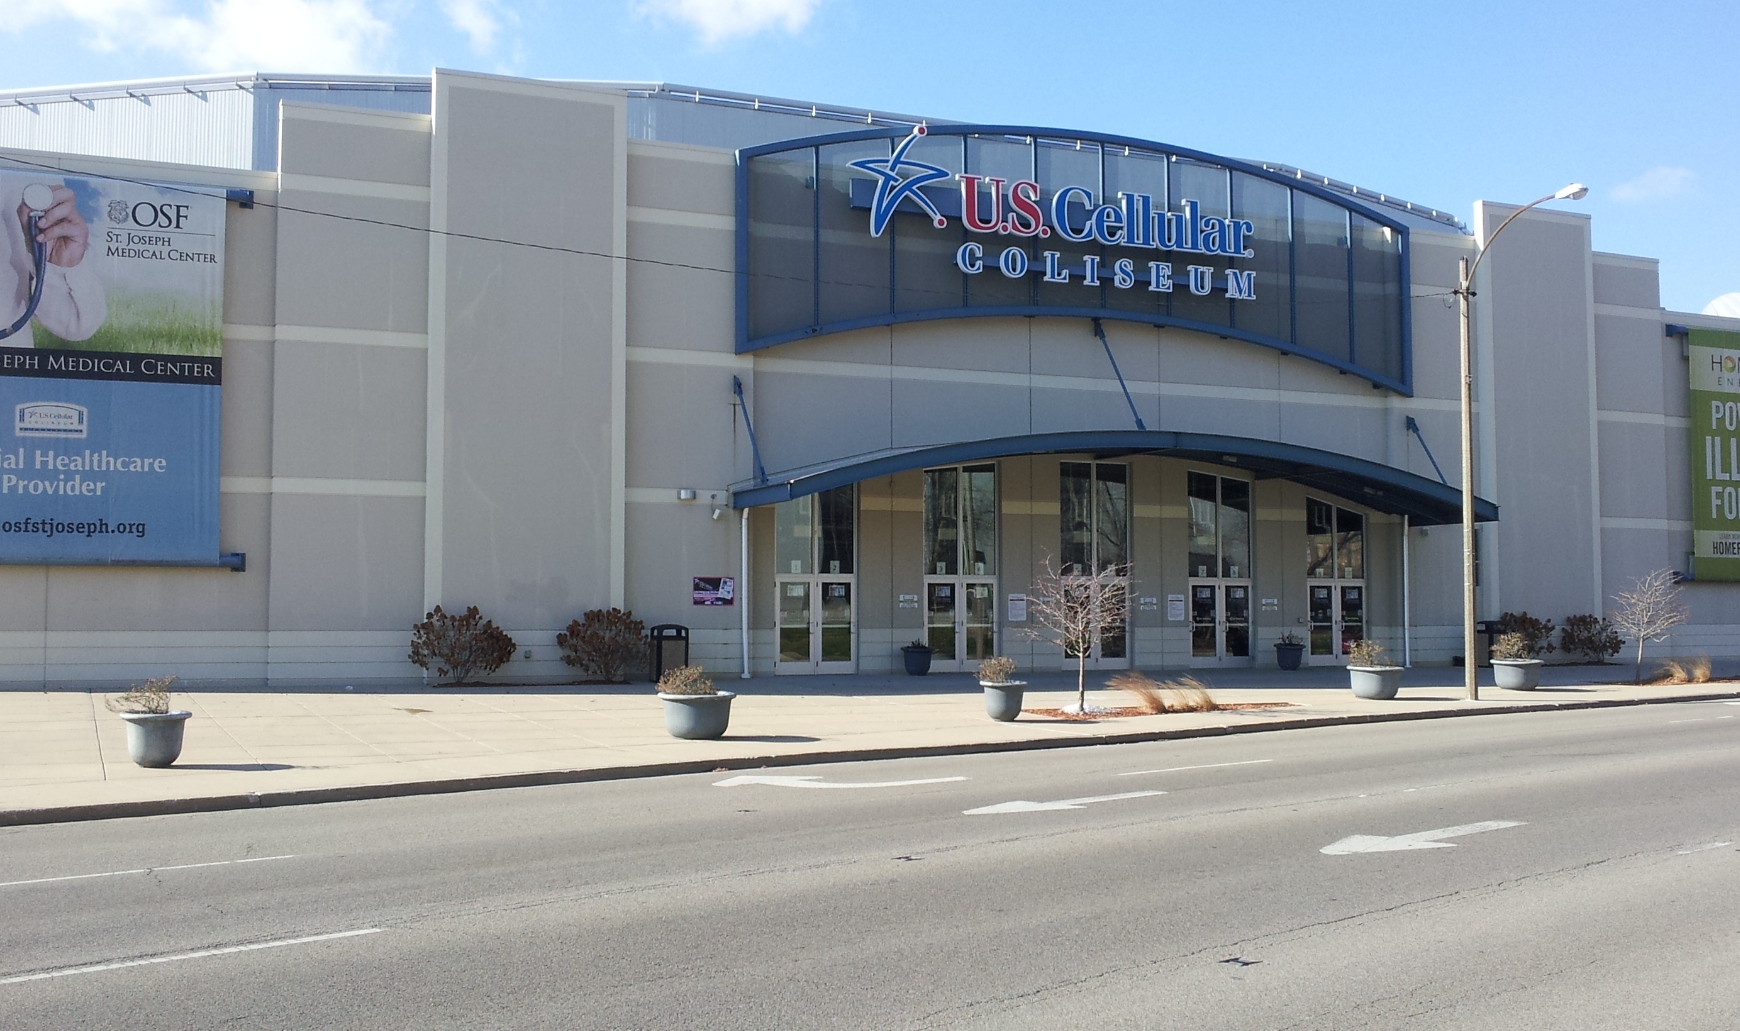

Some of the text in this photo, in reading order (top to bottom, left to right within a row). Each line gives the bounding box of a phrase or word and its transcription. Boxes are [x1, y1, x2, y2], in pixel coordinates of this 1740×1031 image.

[131, 202, 189, 229] OSF
[126, 233, 171, 247] JOSEPH
[106, 245, 217, 263] MEDICAL CENTER
[957, 242, 1256, 299] COLISEUM
[0, 354, 215, 378] EPH MEDICAL CENTER
[1711, 354, 1740, 373] HO
[1711, 400, 1740, 431] PO
[0, 447, 167, 472] al Healthcare
[2, 474, 105, 496] Provider
[1711, 486, 1740, 520] FO
[2, 517, 146, 538] osfstjoseph.org
